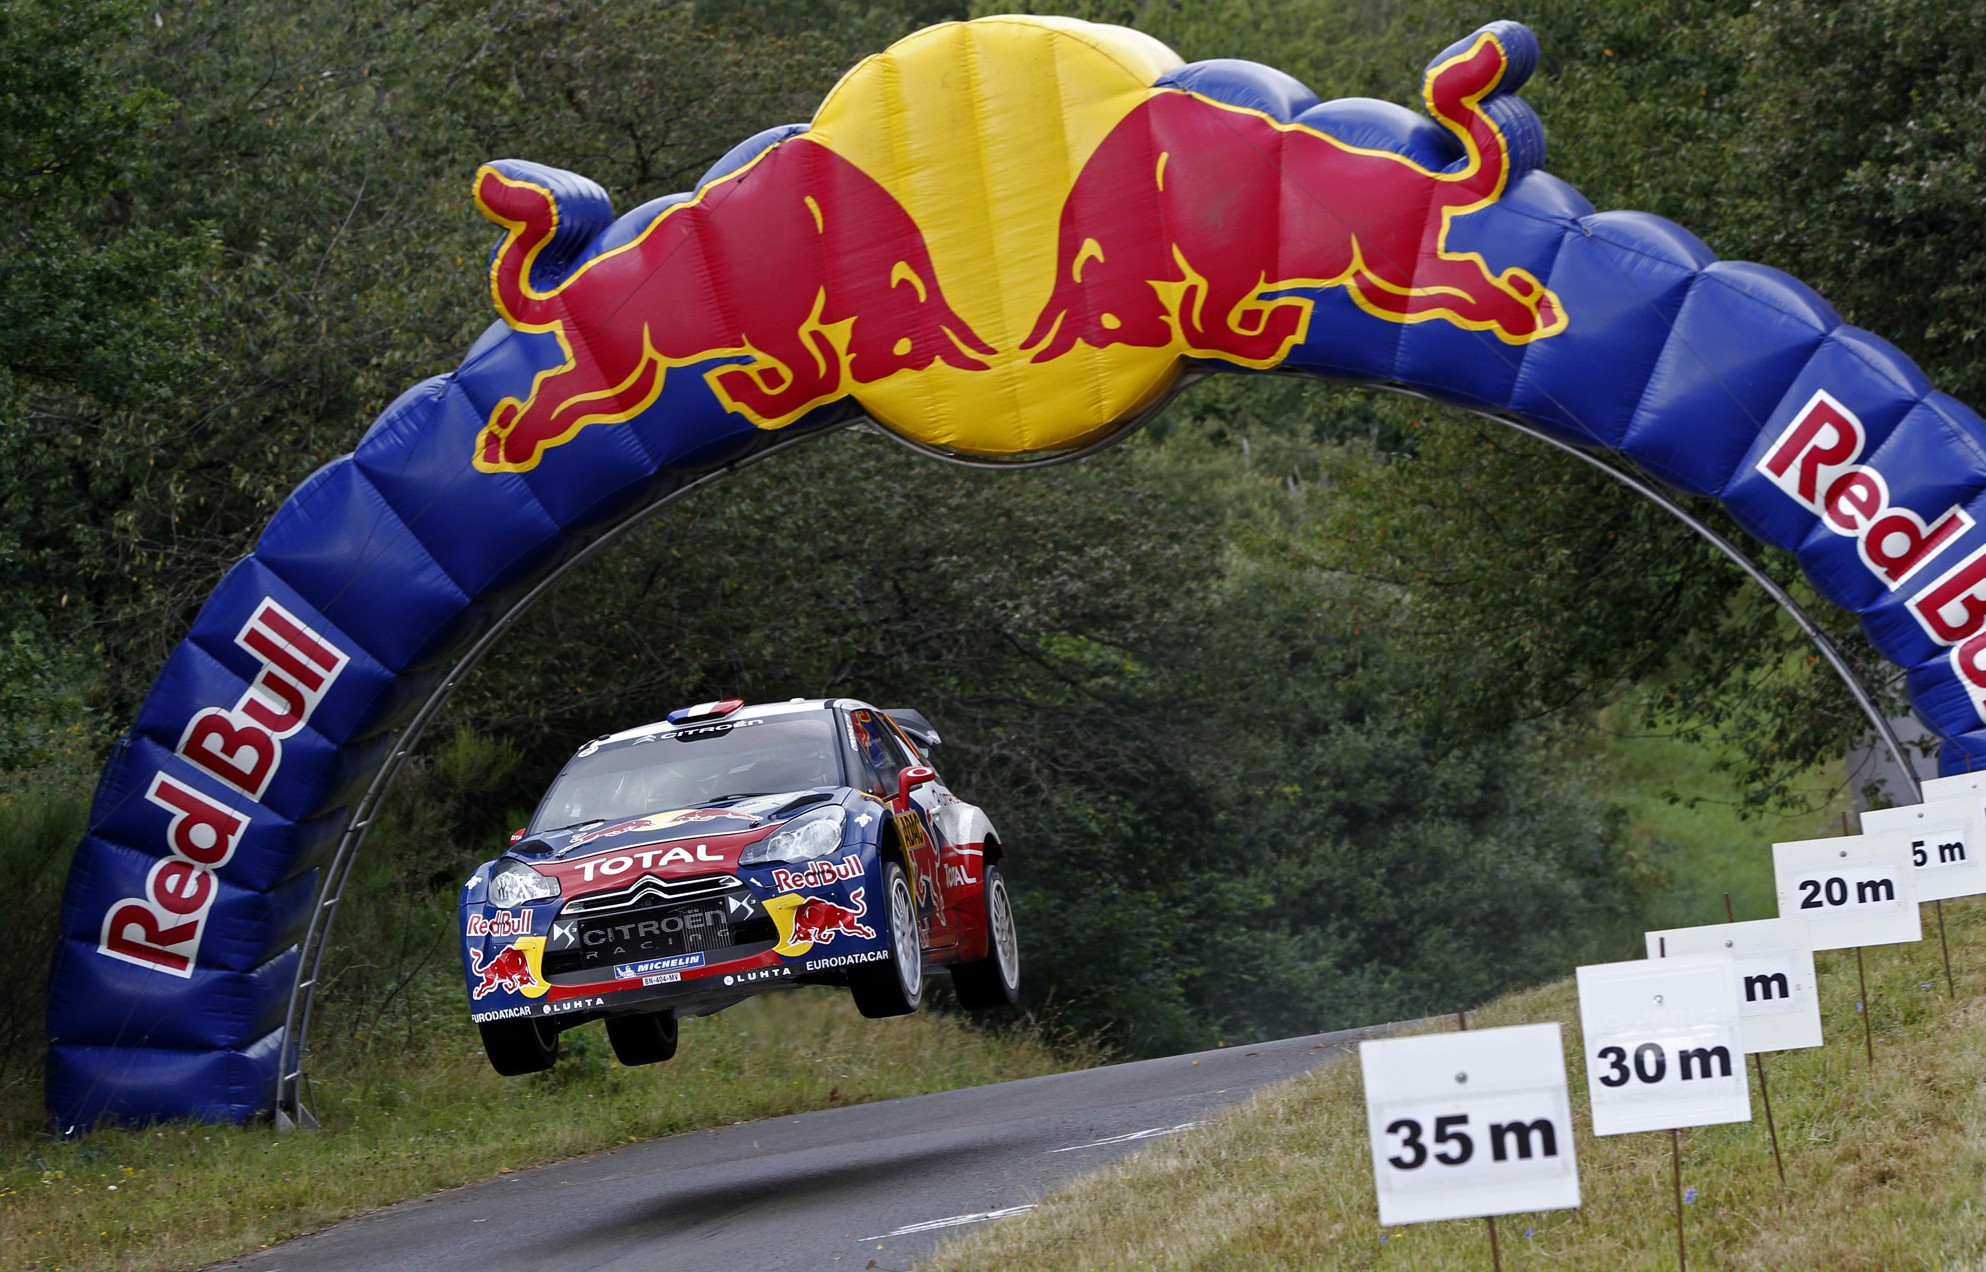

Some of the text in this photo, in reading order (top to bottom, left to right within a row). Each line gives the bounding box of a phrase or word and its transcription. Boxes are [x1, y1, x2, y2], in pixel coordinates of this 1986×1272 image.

[1758, 391, 1973, 589] Red
[100, 599, 347, 976] Red Bull
[901, 814, 924, 848] ADAC
[574, 844, 724, 882] TOTAL
[1911, 840, 1966, 867] 5 m
[772, 854, 865, 893] Red Bull
[944, 864, 977, 888] TOTAL
[1798, 876, 1895, 910] 20 m
[467, 909, 533, 936] Red Bull
[637, 955, 700, 973] MICHELIN
[737, 967, 791, 983] LUHTA
[806, 950, 889, 971] EURODATACAR
[1744, 972, 1790, 1002] m
[553, 997, 605, 1012] LUHTA
[1596, 1042, 1732, 1088] 30 m
[1385, 1114, 1558, 1170] 35 m
